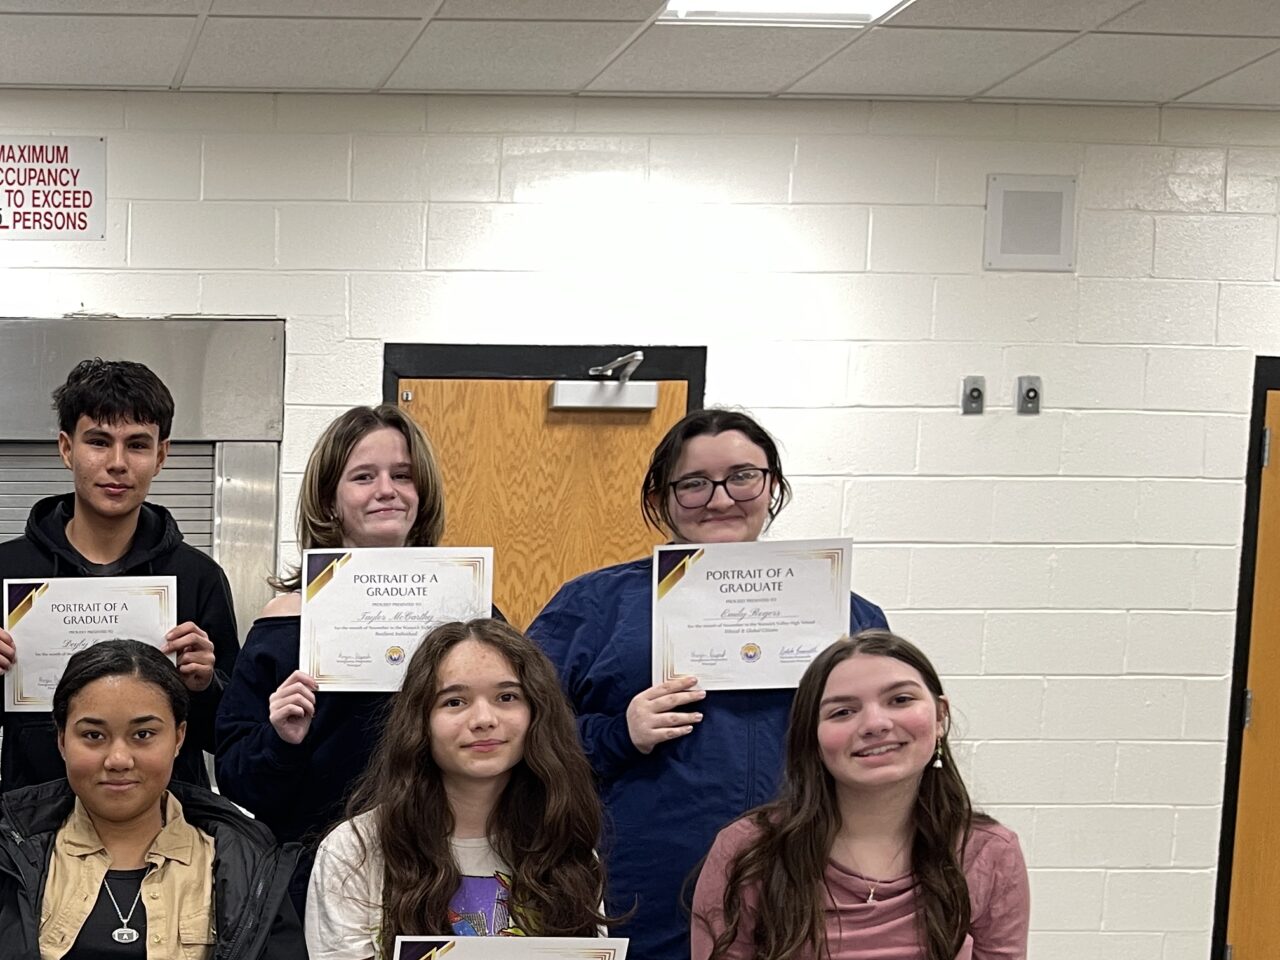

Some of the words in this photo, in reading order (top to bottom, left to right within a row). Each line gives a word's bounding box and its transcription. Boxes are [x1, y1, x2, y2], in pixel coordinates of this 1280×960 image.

[5, 189, 25, 207] TO
[32, 190, 93, 208] EXCEED
[12, 211, 88, 230] PERSONS
[353, 574, 408, 584] PORTRAIT
[411, 574, 427, 583] OF
[429, 574, 438, 583] A
[706, 569, 764, 581] PORTRAIT
[766, 568, 782, 578] OF
[785, 568, 794, 577] A
[366, 587, 428, 596] GRADUATE
[719, 582, 784, 593] GRADUATE
[51, 603, 101, 612] PORTRAIT
[104, 603, 117, 612] OF
[121, 602, 128, 611] A
[63, 615, 120, 625] GRADUATE
